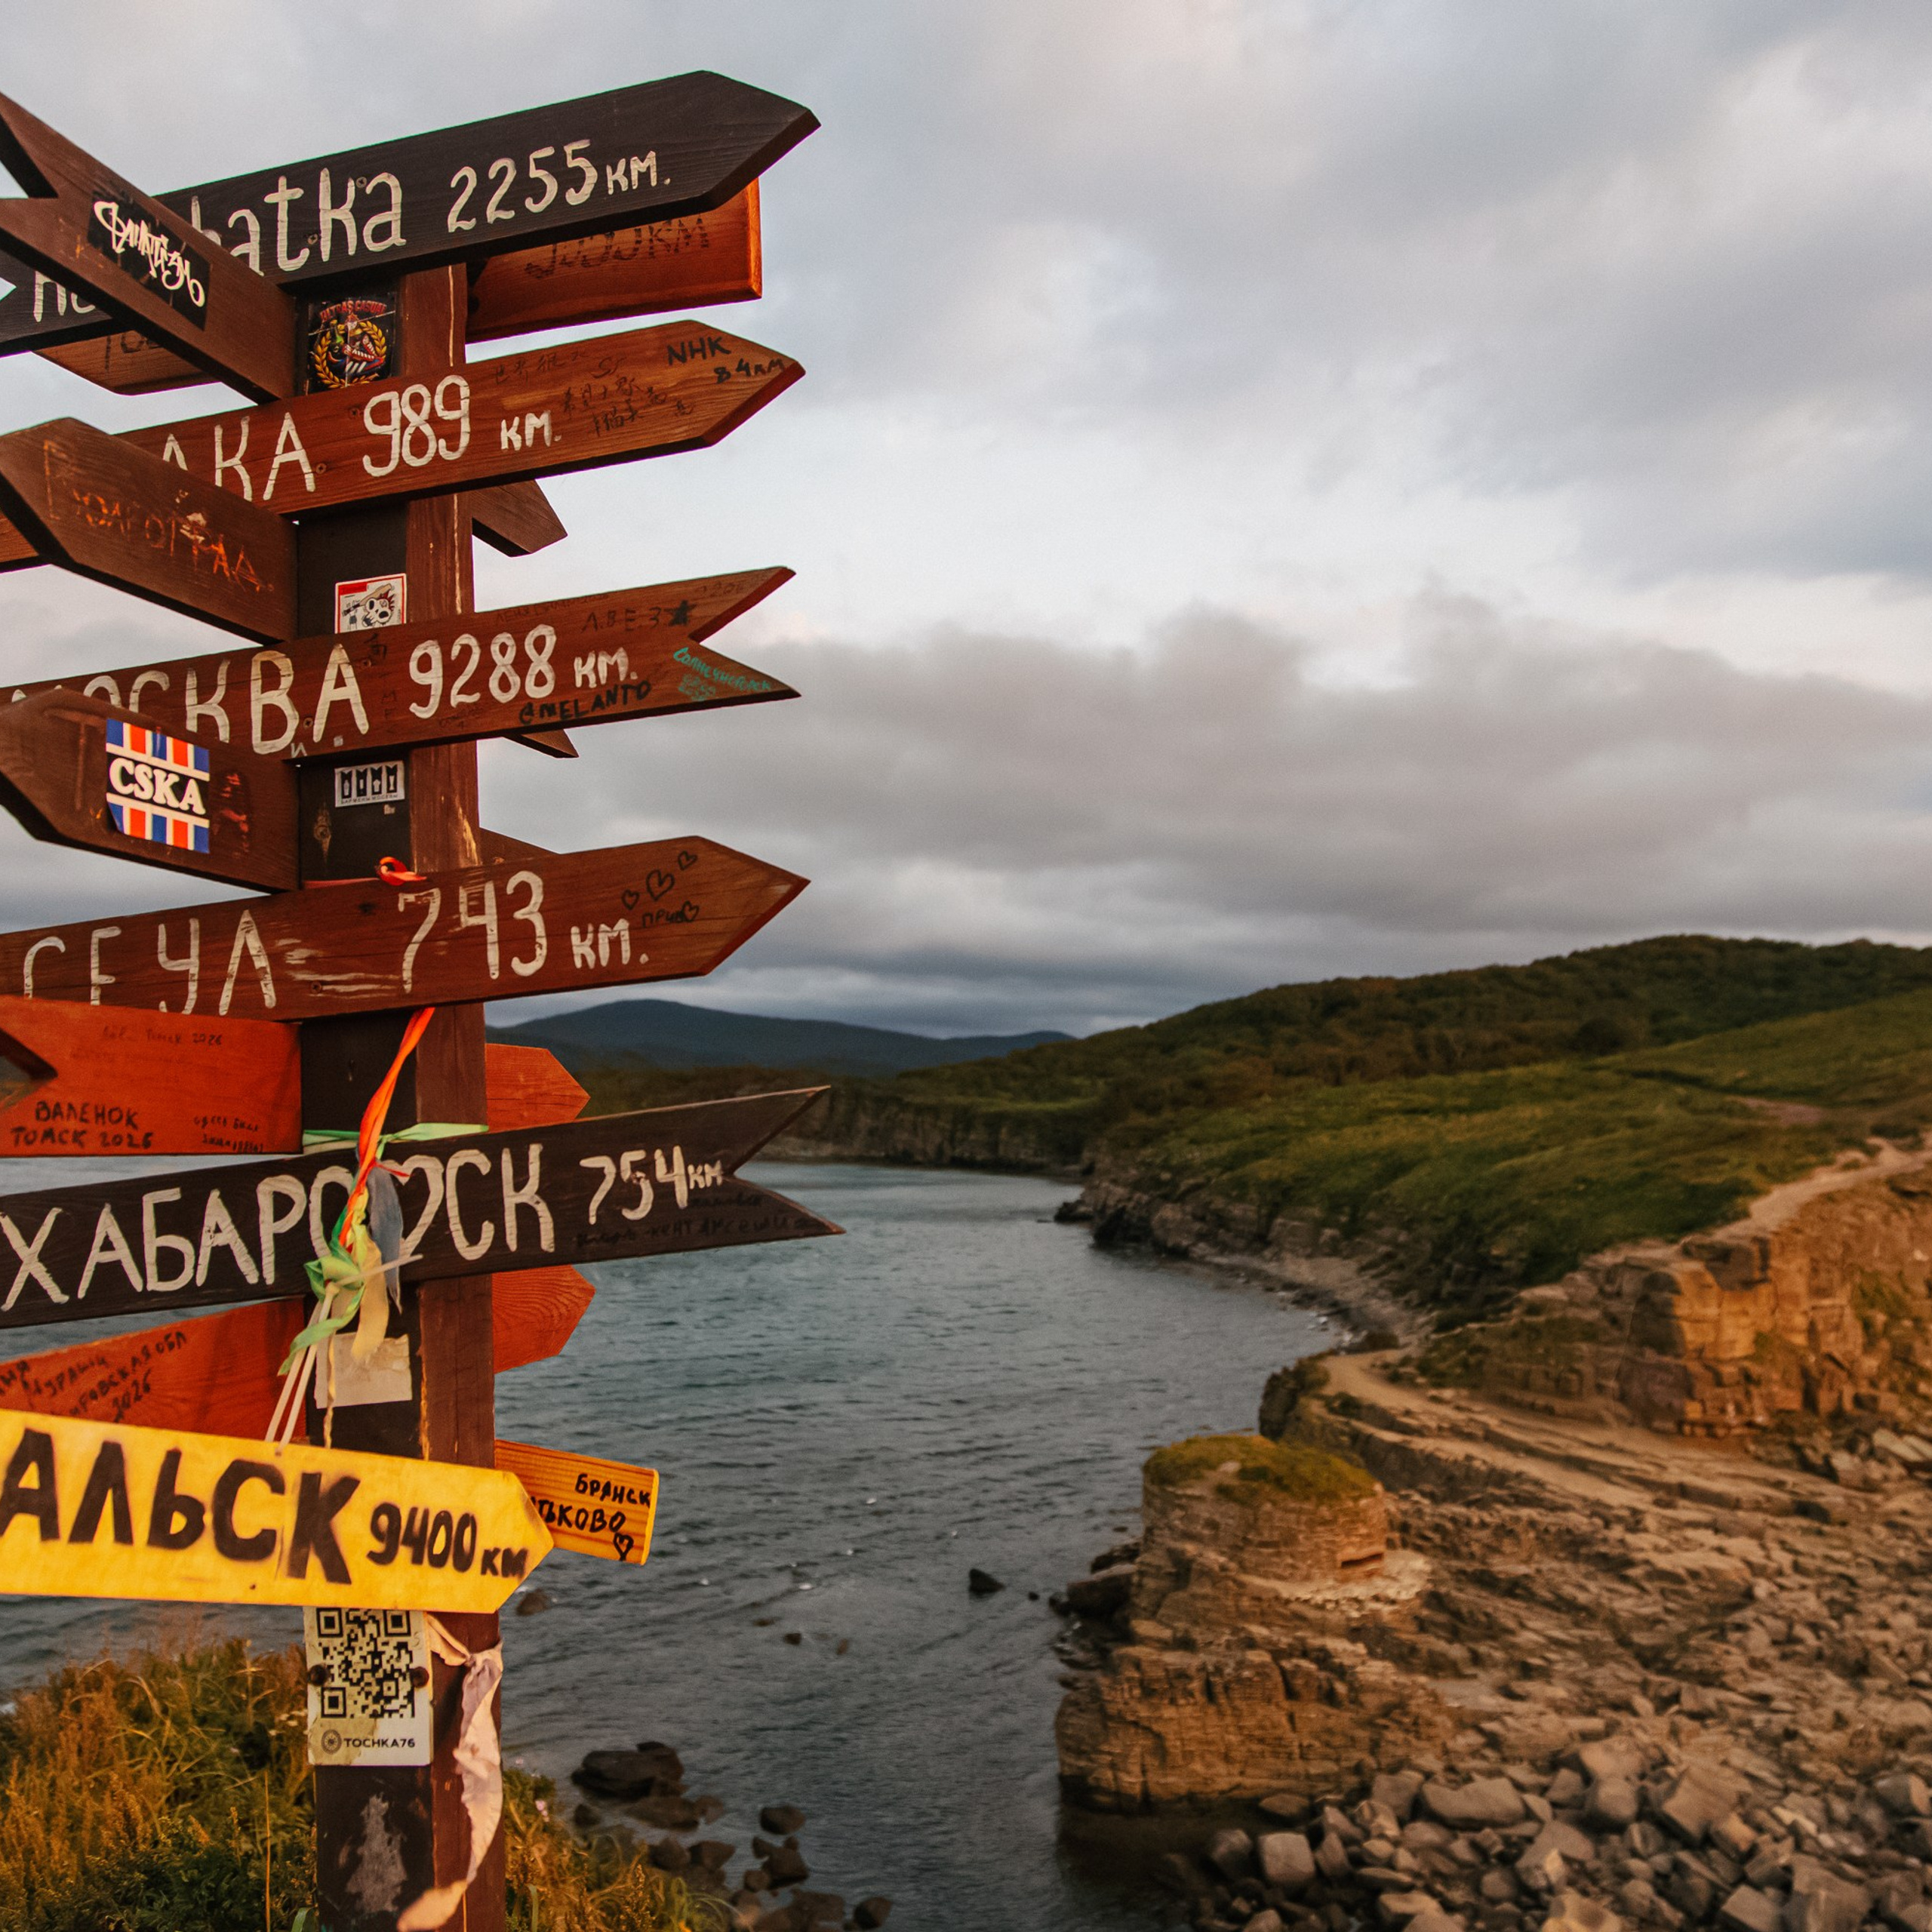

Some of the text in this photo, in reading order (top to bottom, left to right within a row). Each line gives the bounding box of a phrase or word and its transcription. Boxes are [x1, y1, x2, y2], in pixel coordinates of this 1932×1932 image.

[448, 139, 598, 233] 2255
[363, 375, 469, 476] 989
[11, 640, 368, 755] СКВА
[409, 624, 556, 719] 9288
[109, 757, 206, 815] CSKA
[398, 871, 548, 993] 743
[35, 1100, 139, 1131] ВАЛЕНОК
[580, 1146, 688, 1224] 754
[0, 1429, 361, 1585] АЛЬСК
[368, 1501, 478, 1573] 9400
[530, 1497, 626, 1533] ТЬКОВО
[343, 1737, 416, 1749] TOCHKA76
